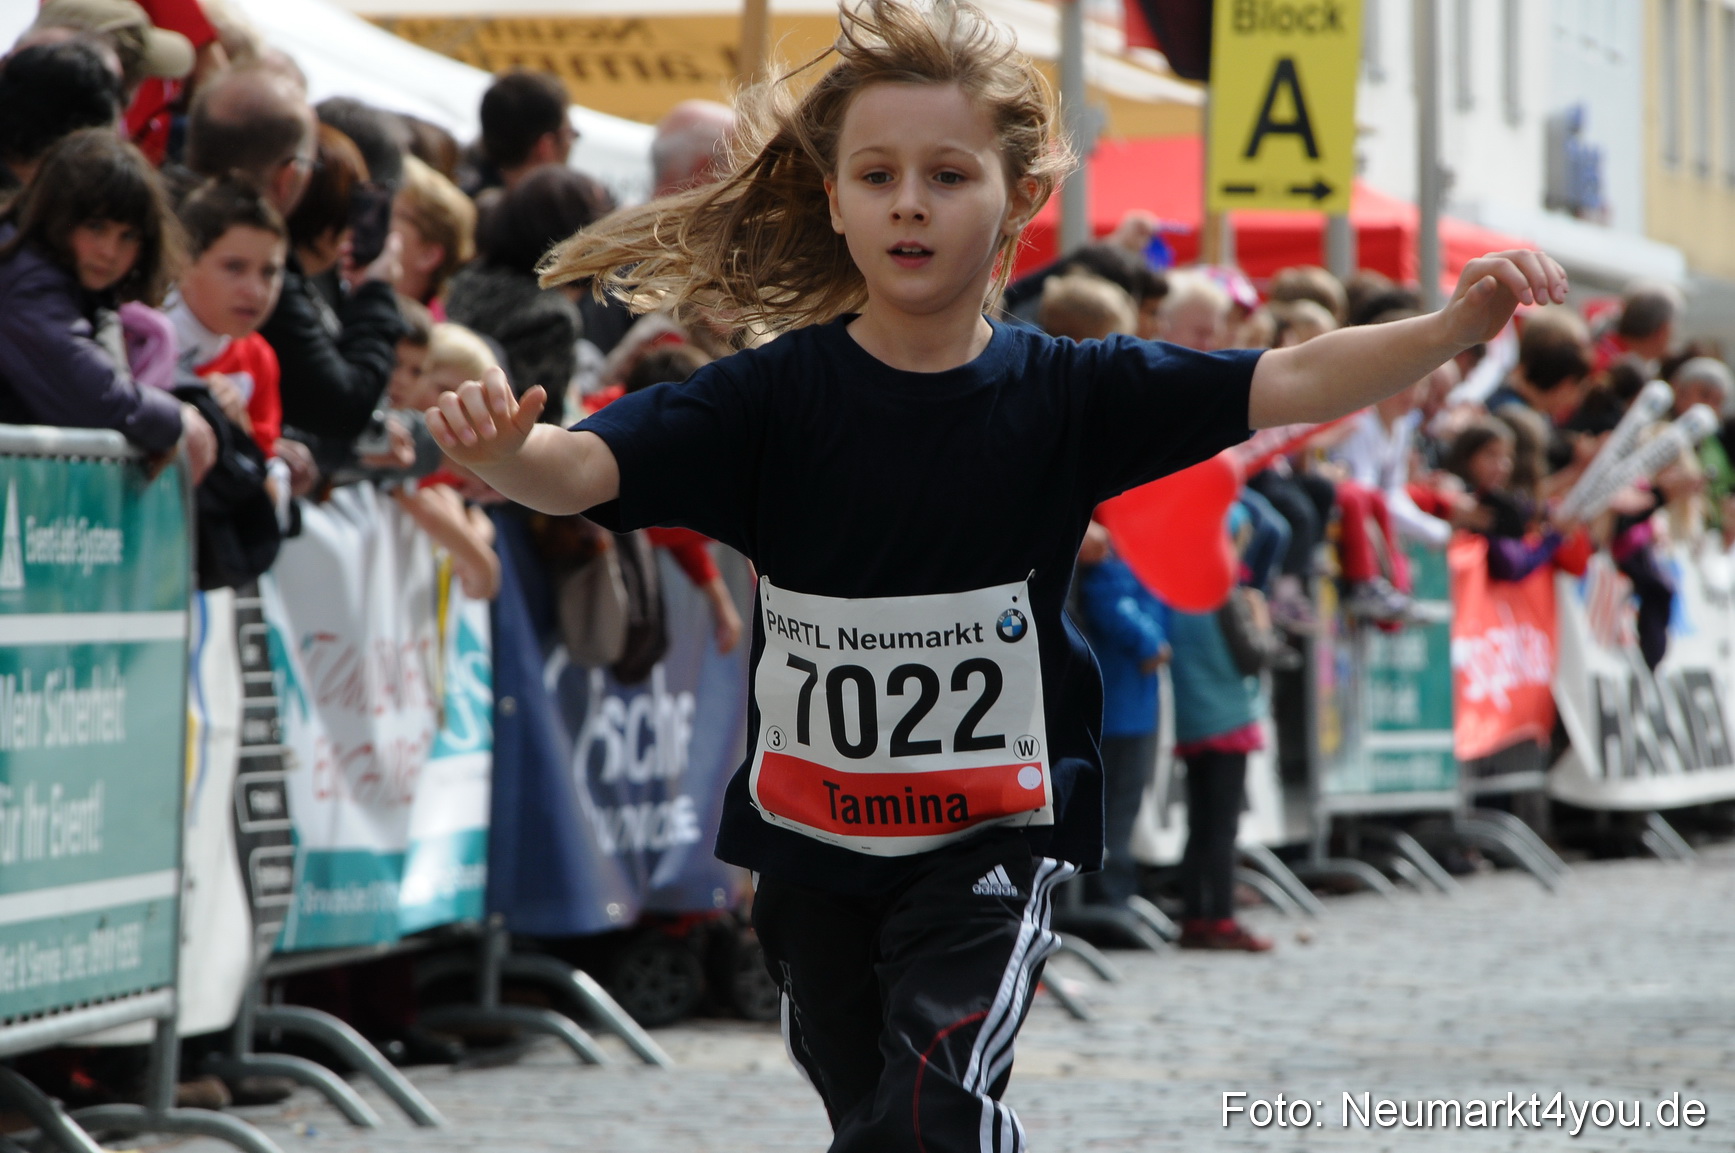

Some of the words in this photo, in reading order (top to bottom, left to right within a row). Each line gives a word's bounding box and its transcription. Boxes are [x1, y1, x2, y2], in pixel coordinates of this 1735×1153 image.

[1232, 0, 1344, 35] Block
[1244, 56, 1320, 160] A
[766, 608, 830, 650] PARTL
[838, 622, 984, 650] Neumarkt
[786, 652, 1006, 759] 7022
[772, 731, 781, 747] 3
[1017, 740, 1035, 757] W
[822, 780, 970, 825] Tamina
[972, 883, 1018, 897] adidas
